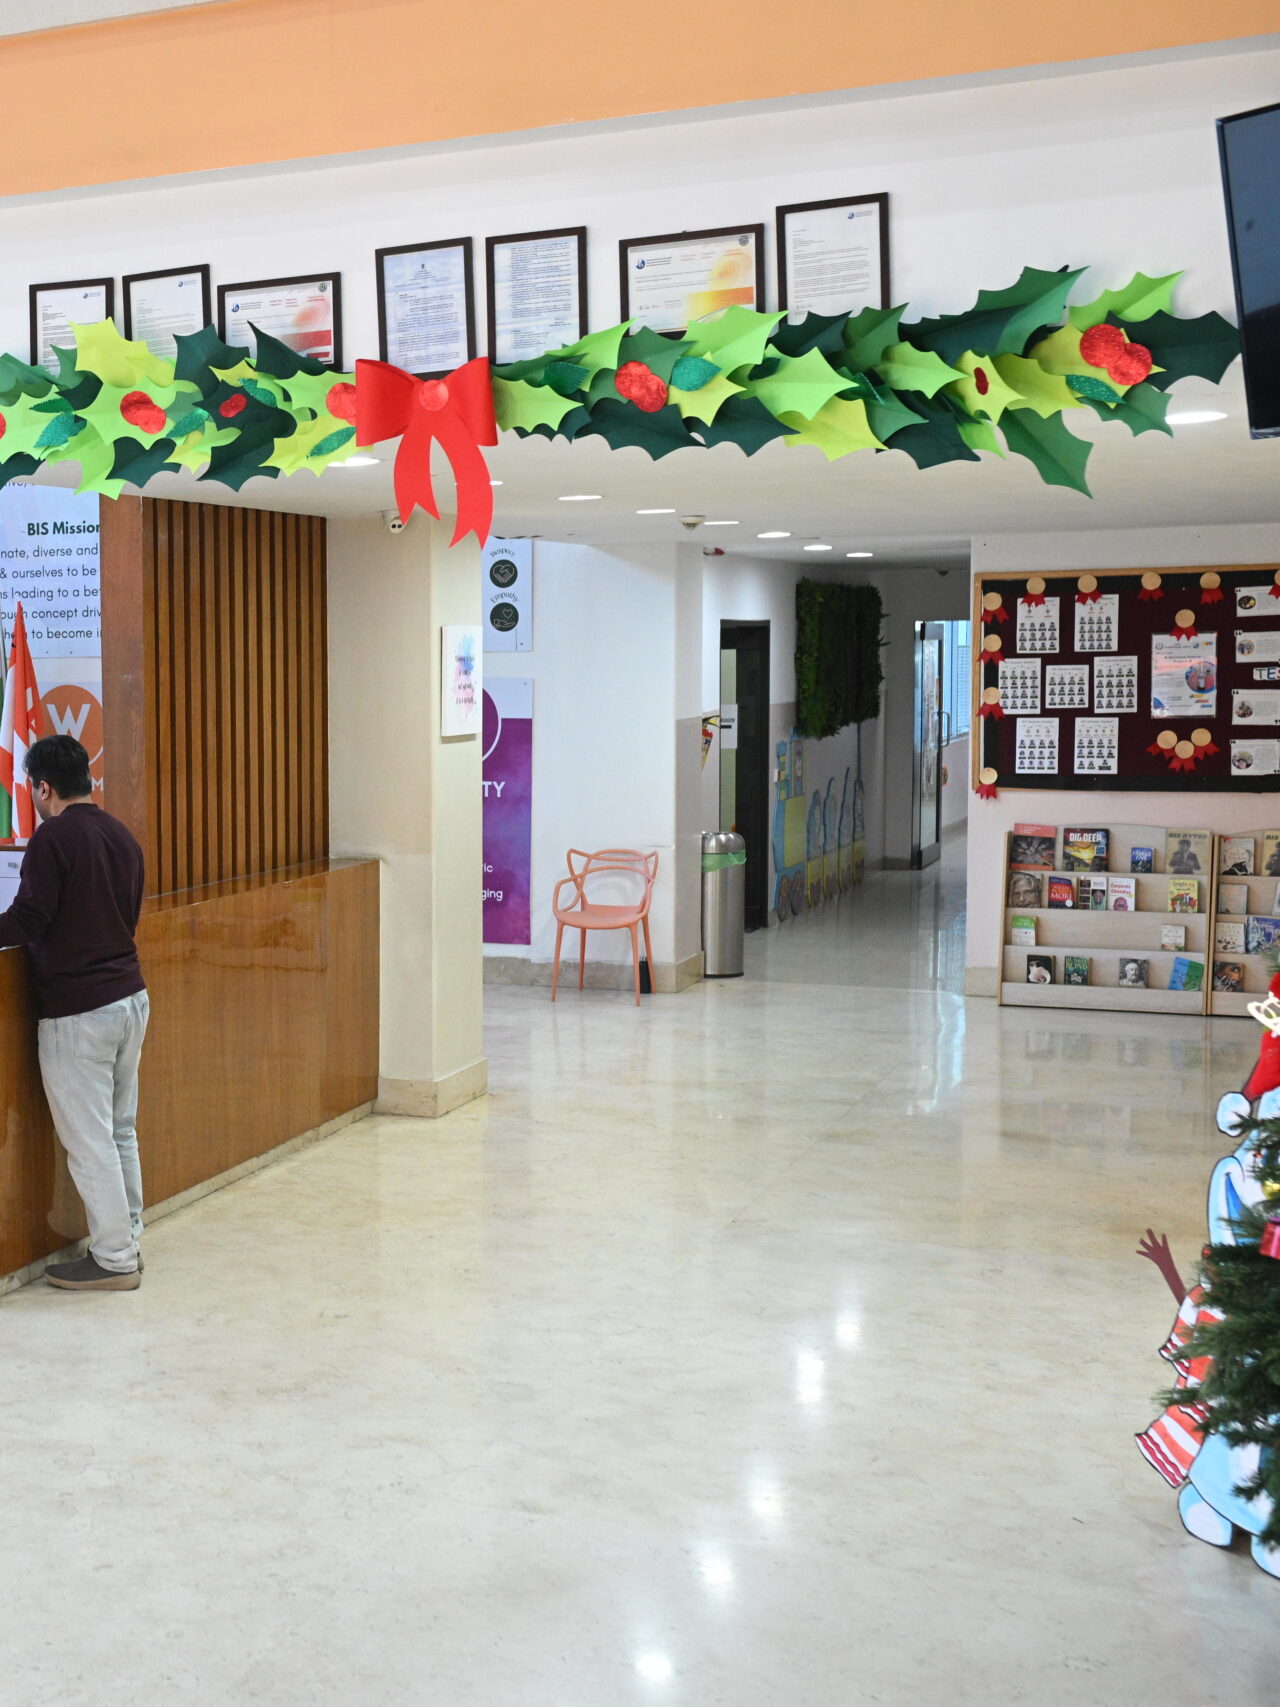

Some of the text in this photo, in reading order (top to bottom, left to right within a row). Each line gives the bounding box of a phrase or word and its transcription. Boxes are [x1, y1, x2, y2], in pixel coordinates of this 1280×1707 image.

[27, 522, 48, 536] BIS
[33, 545, 72, 558] diverse
[76, 543, 98, 555] and
[0, 568, 7, 578] &
[12, 566, 63, 578] ourselves
[67, 567, 78, 577] to
[82, 564, 96, 576] be
[58, 588, 68, 597] to
[73, 589, 79, 597] a
[32, 609, 78, 621] concept
[32, 630, 43, 639] to
[47, 627, 92, 639] become
